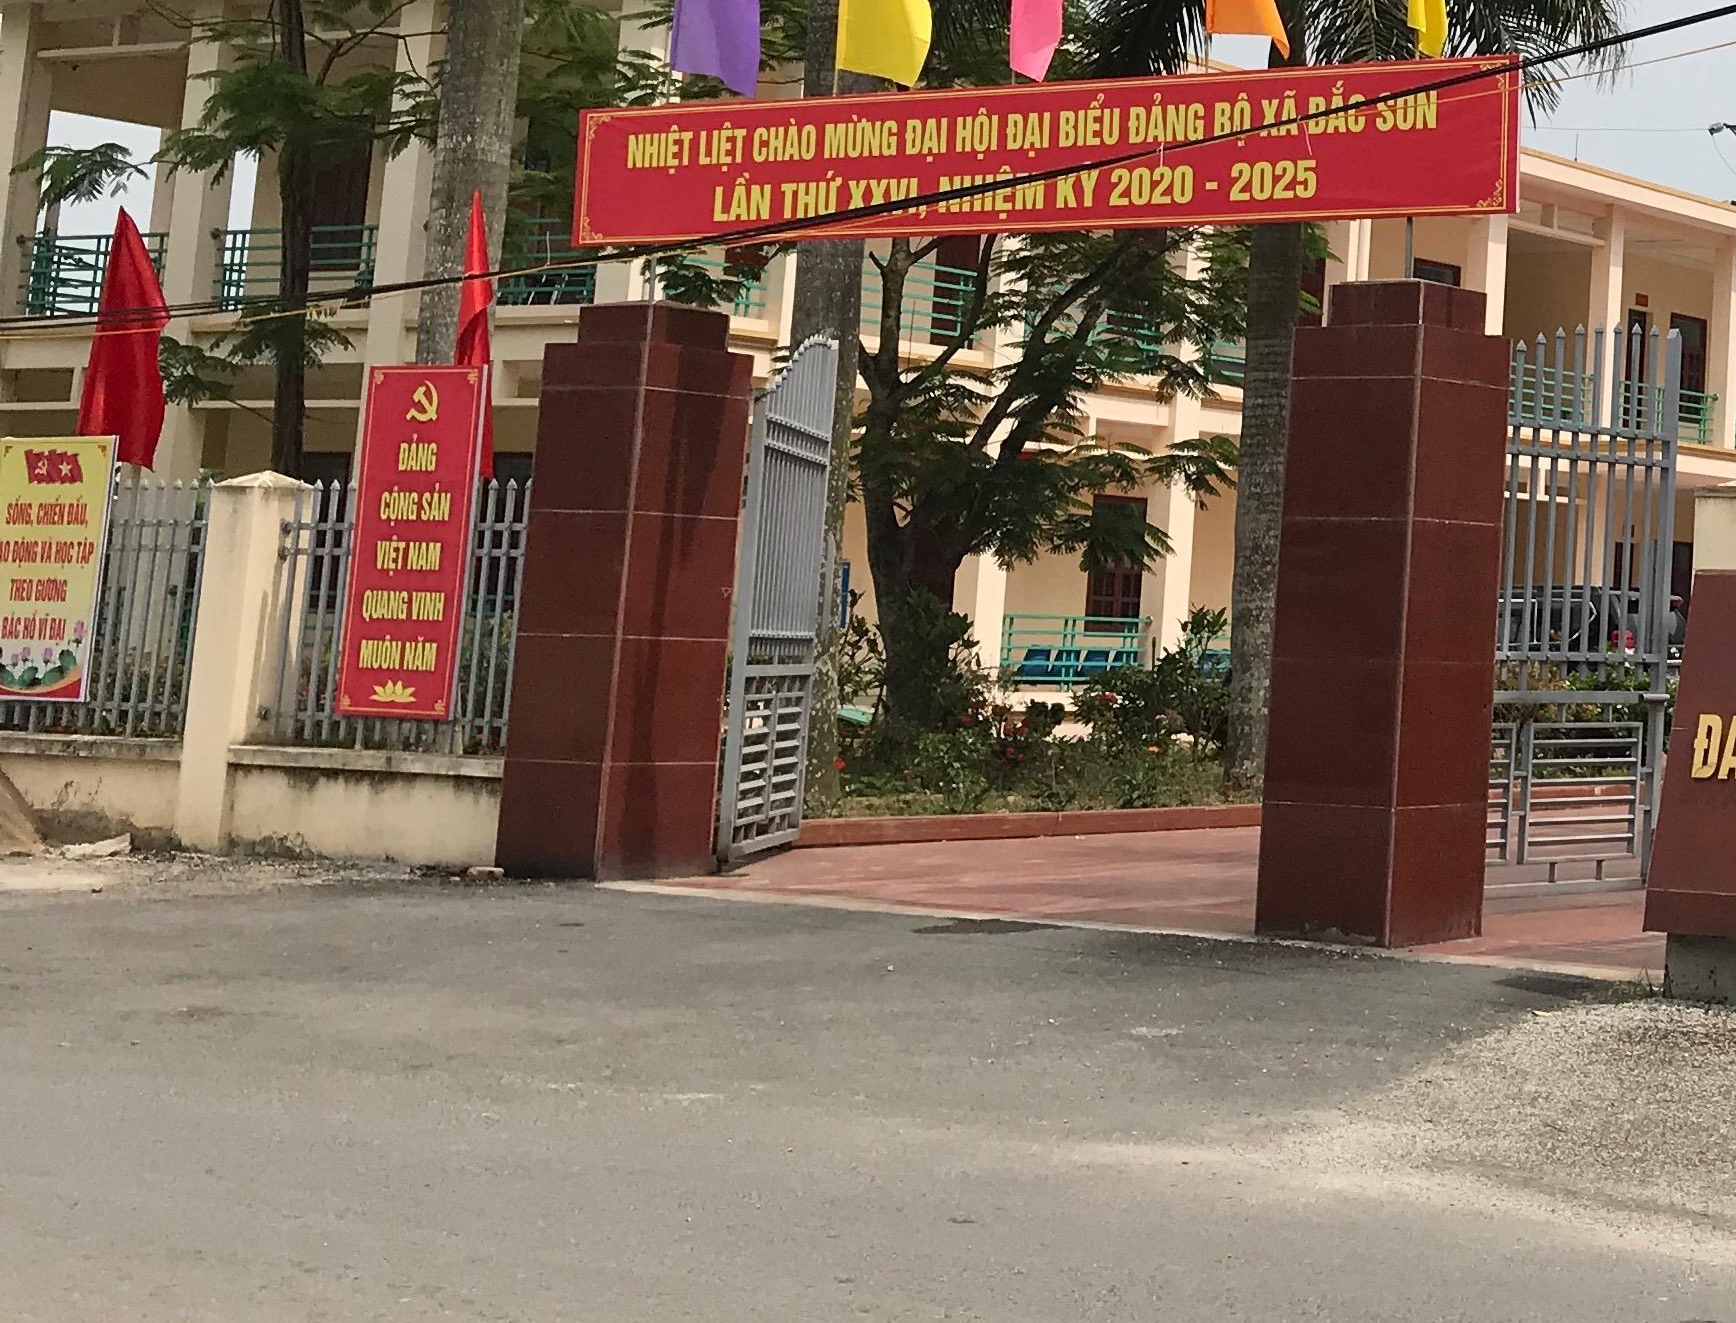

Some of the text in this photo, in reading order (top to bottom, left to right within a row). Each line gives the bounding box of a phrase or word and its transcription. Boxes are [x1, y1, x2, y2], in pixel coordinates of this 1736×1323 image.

[627, 125, 694, 175] NHIỆT
[699, 122, 747, 172] LIỆT
[753, 118, 816, 163] CHÀO
[824, 113, 898, 158] MỪNG
[905, 118, 948, 163] ĐẠI
[956, 108, 999, 160] HỘI
[1006, 112, 1050, 158] ĐẠI
[1059, 93, 1121, 148] BIỂU
[1128, 92, 1205, 144] ĐẢNG
[1214, 92, 1251, 147] BỘ
[1260, 89, 1298, 137] XÃ
[1308, 80, 1366, 135] BẮC
[713, 172, 772, 221] LẦN
[781, 170, 840, 219] THỨ
[845, 177, 927, 219] XXVI,
[938, 165, 1045, 219] NHIỆM
[1109, 165, 1193, 206] 2020
[1205, 181, 1219, 190] -
[1229, 160, 1317, 201] 2025
[399, 434, 437, 471] ĐẢNG
[380, 482, 450, 526] CỘNG SẢN
[55, 541, 74, 569] HỌC
[376, 535, 441, 576] VIỆT NAM
[9, 578, 33, 601] THEO
[362, 589, 445, 623] QUANG VINH
[1, 612, 21, 639] BÁC
[49, 617, 66, 646] ĐẠI
[359, 635, 438, 672] MUÔN NĂM
